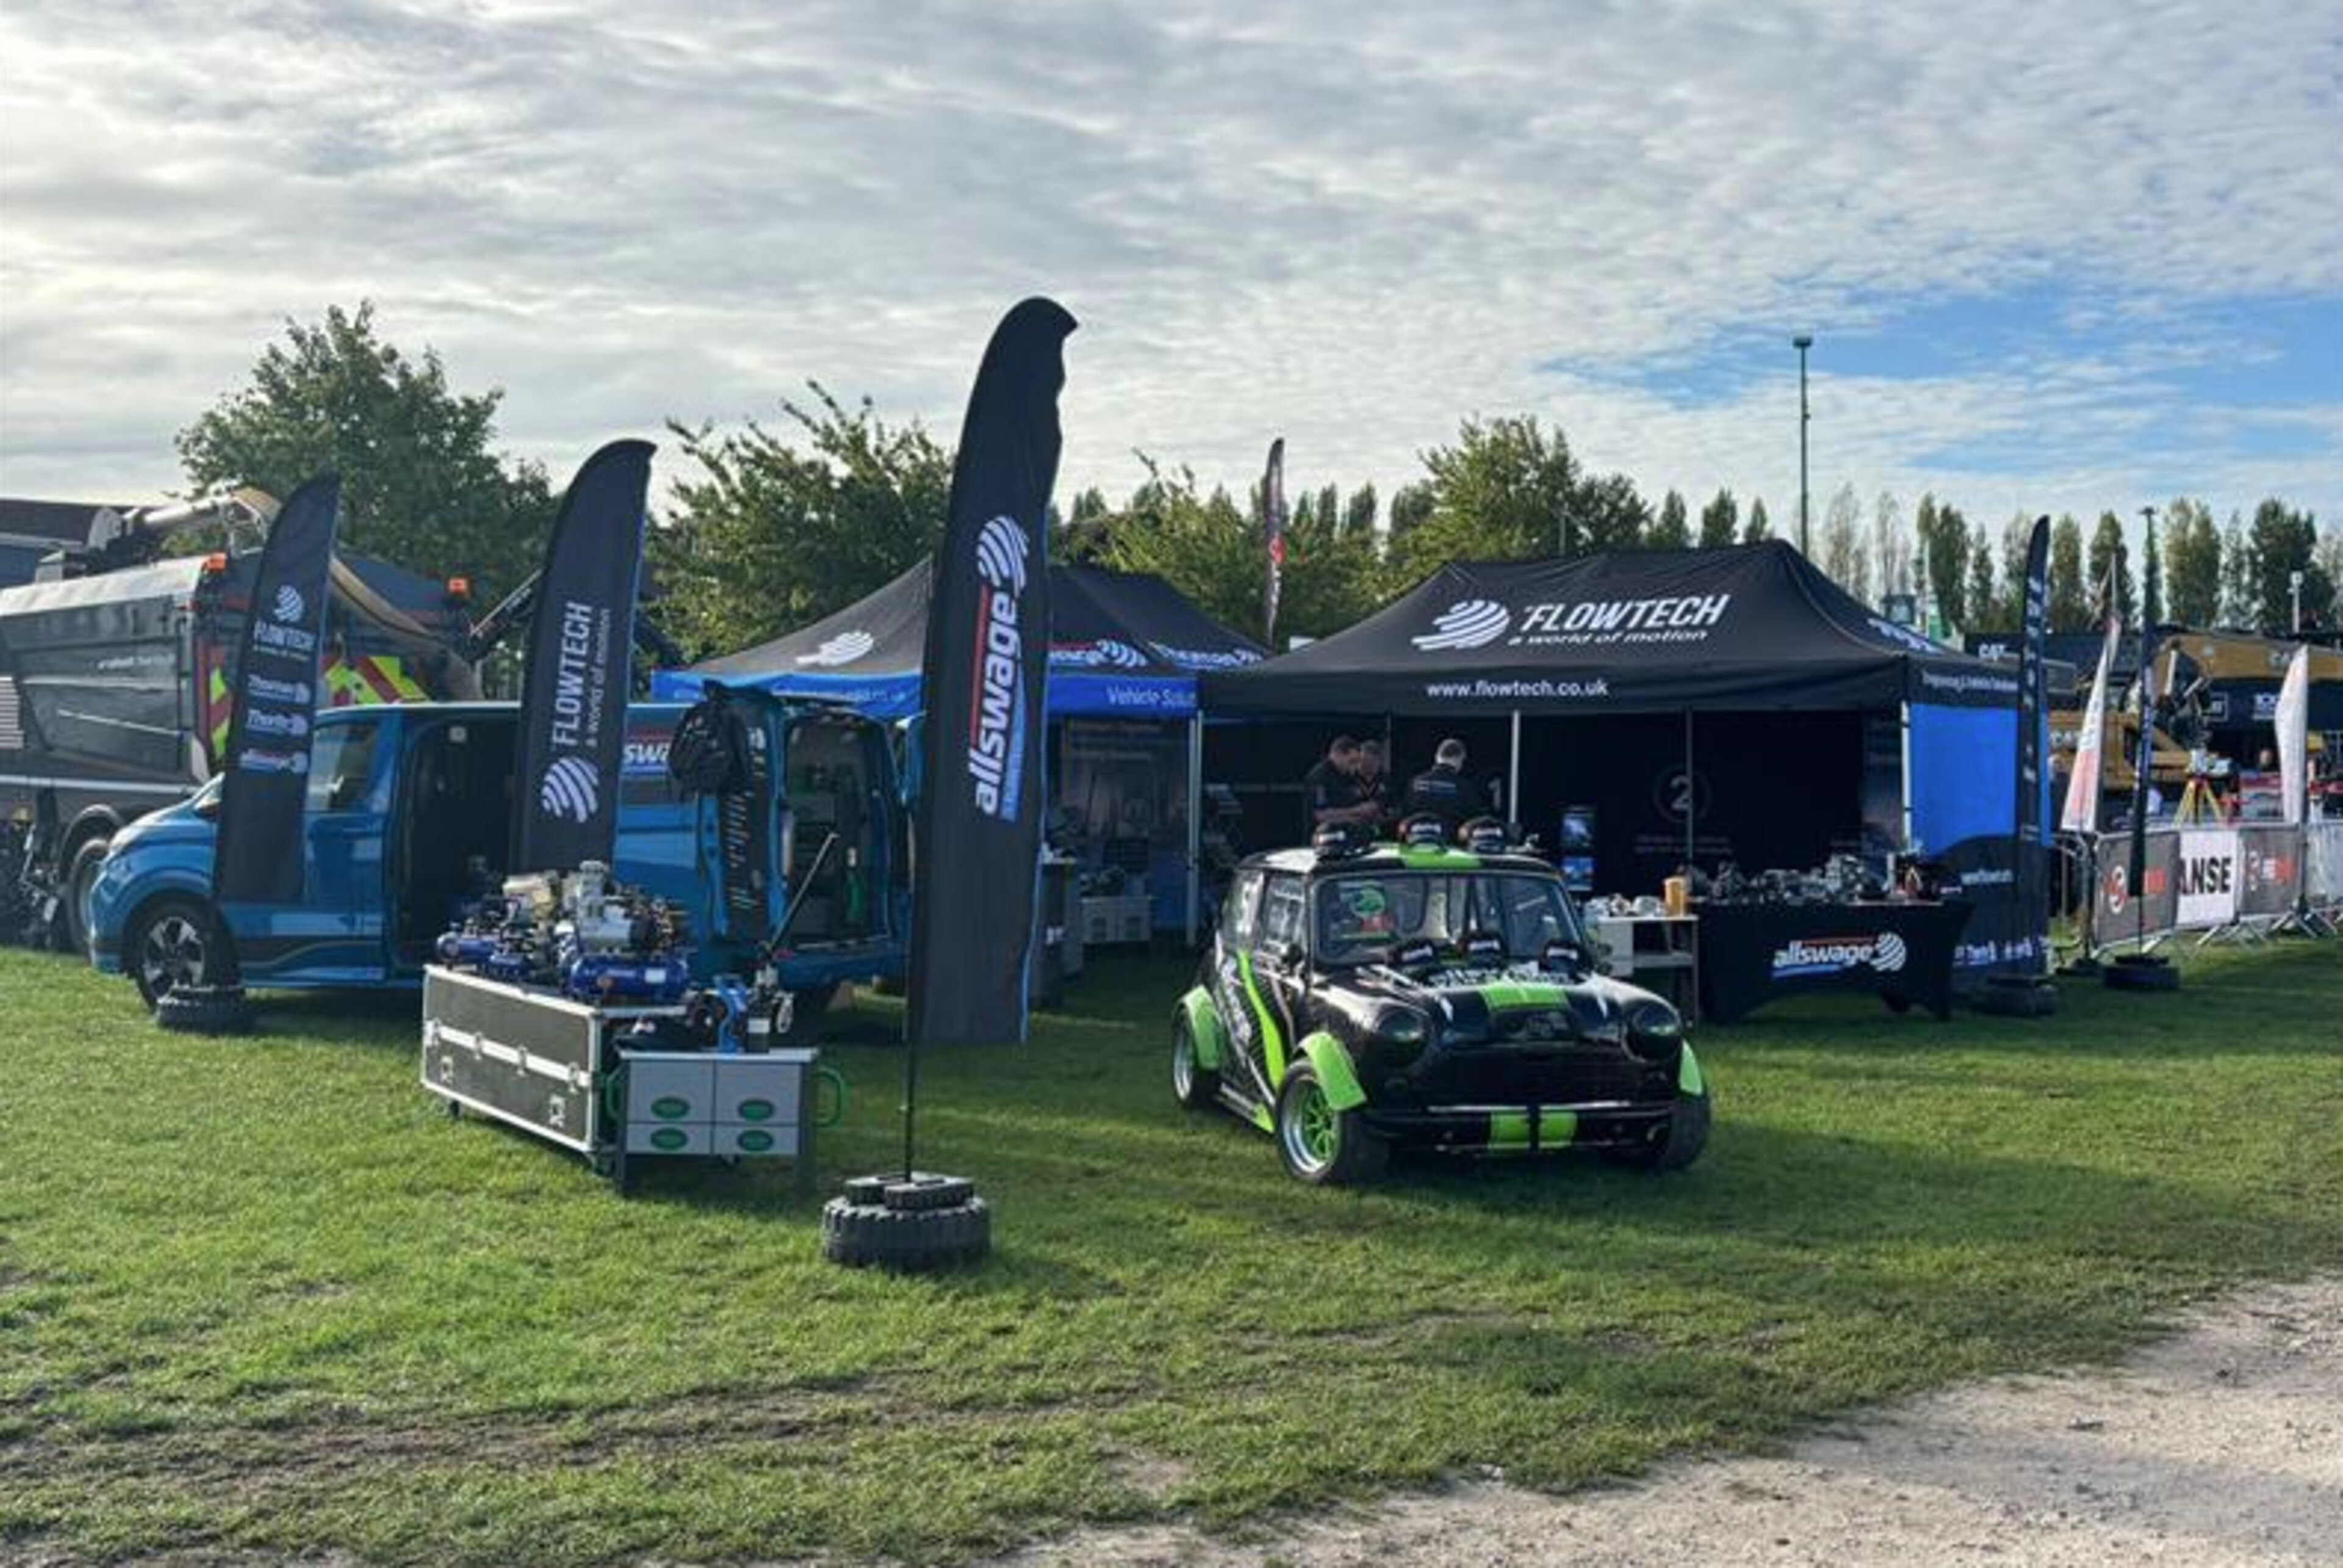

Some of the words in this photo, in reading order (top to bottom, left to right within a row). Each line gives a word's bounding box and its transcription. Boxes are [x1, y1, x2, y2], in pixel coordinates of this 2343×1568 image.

[1520, 594, 1730, 632] FLOWTECH
[1595, 631, 1621, 644] of
[1624, 630, 1707, 643] motion
[552, 601, 592, 747] FLOWTECH
[1427, 678, 1610, 697] www.flowtech.co.uk
[969, 591, 1020, 816] allswage
[1106, 685, 1159, 705] Vehicle
[1670, 774, 1693, 810] 2
[1773, 941, 1873, 968] allswage
